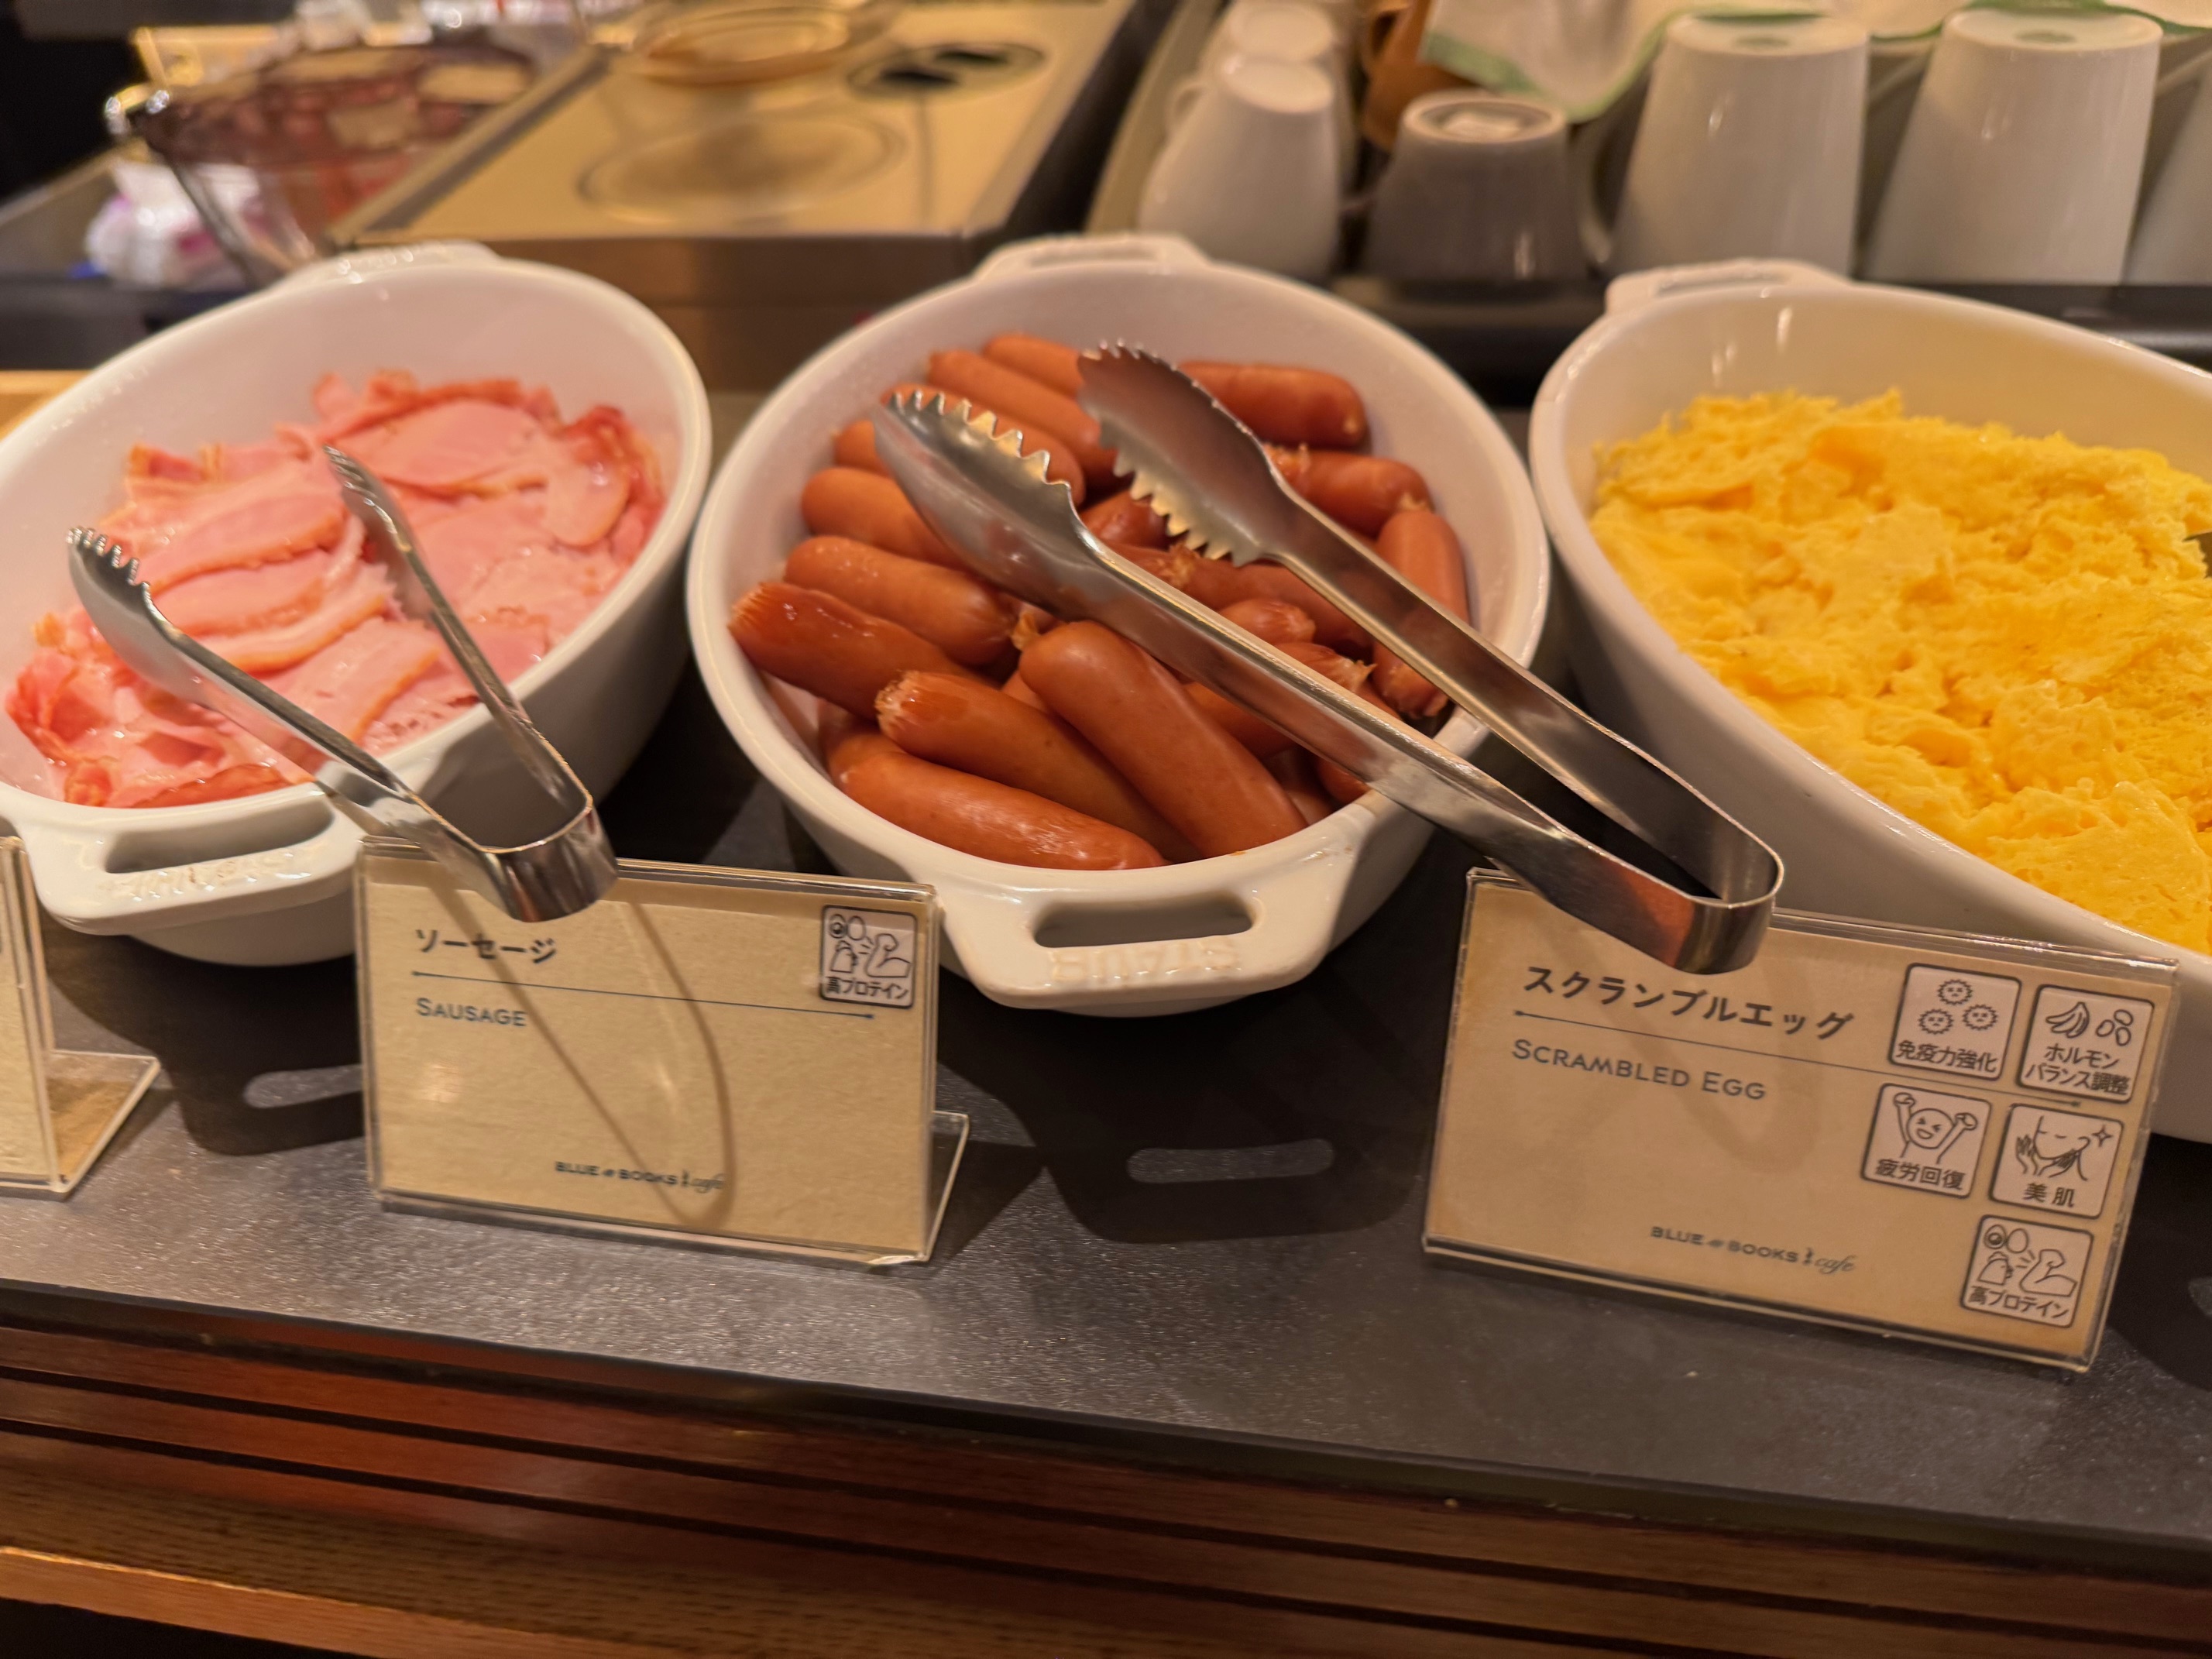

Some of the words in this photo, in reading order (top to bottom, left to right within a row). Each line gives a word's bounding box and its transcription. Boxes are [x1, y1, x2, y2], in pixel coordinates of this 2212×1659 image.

[415, 929, 558, 964] ソーセージ
[415, 997, 528, 1027] SAUSAGE
[1523, 965, 1855, 1040] スクランブルエッグ
[1512, 1038, 1691, 1087] SCRAMBLED
[1701, 1070, 1767, 1101] EGG
[1895, 1039, 1997, 1073] 免疫力強化
[2043, 1042, 2121, 1070] ホルモン
[2025, 1062, 2132, 1096] バランス調整
[1875, 1159, 1966, 1191] 疲労回復
[1650, 1225, 1705, 1246] BLUE
[1726, 1239, 1799, 1264] BOOKS
[1968, 1285, 2069, 1319] 高プロテイン
